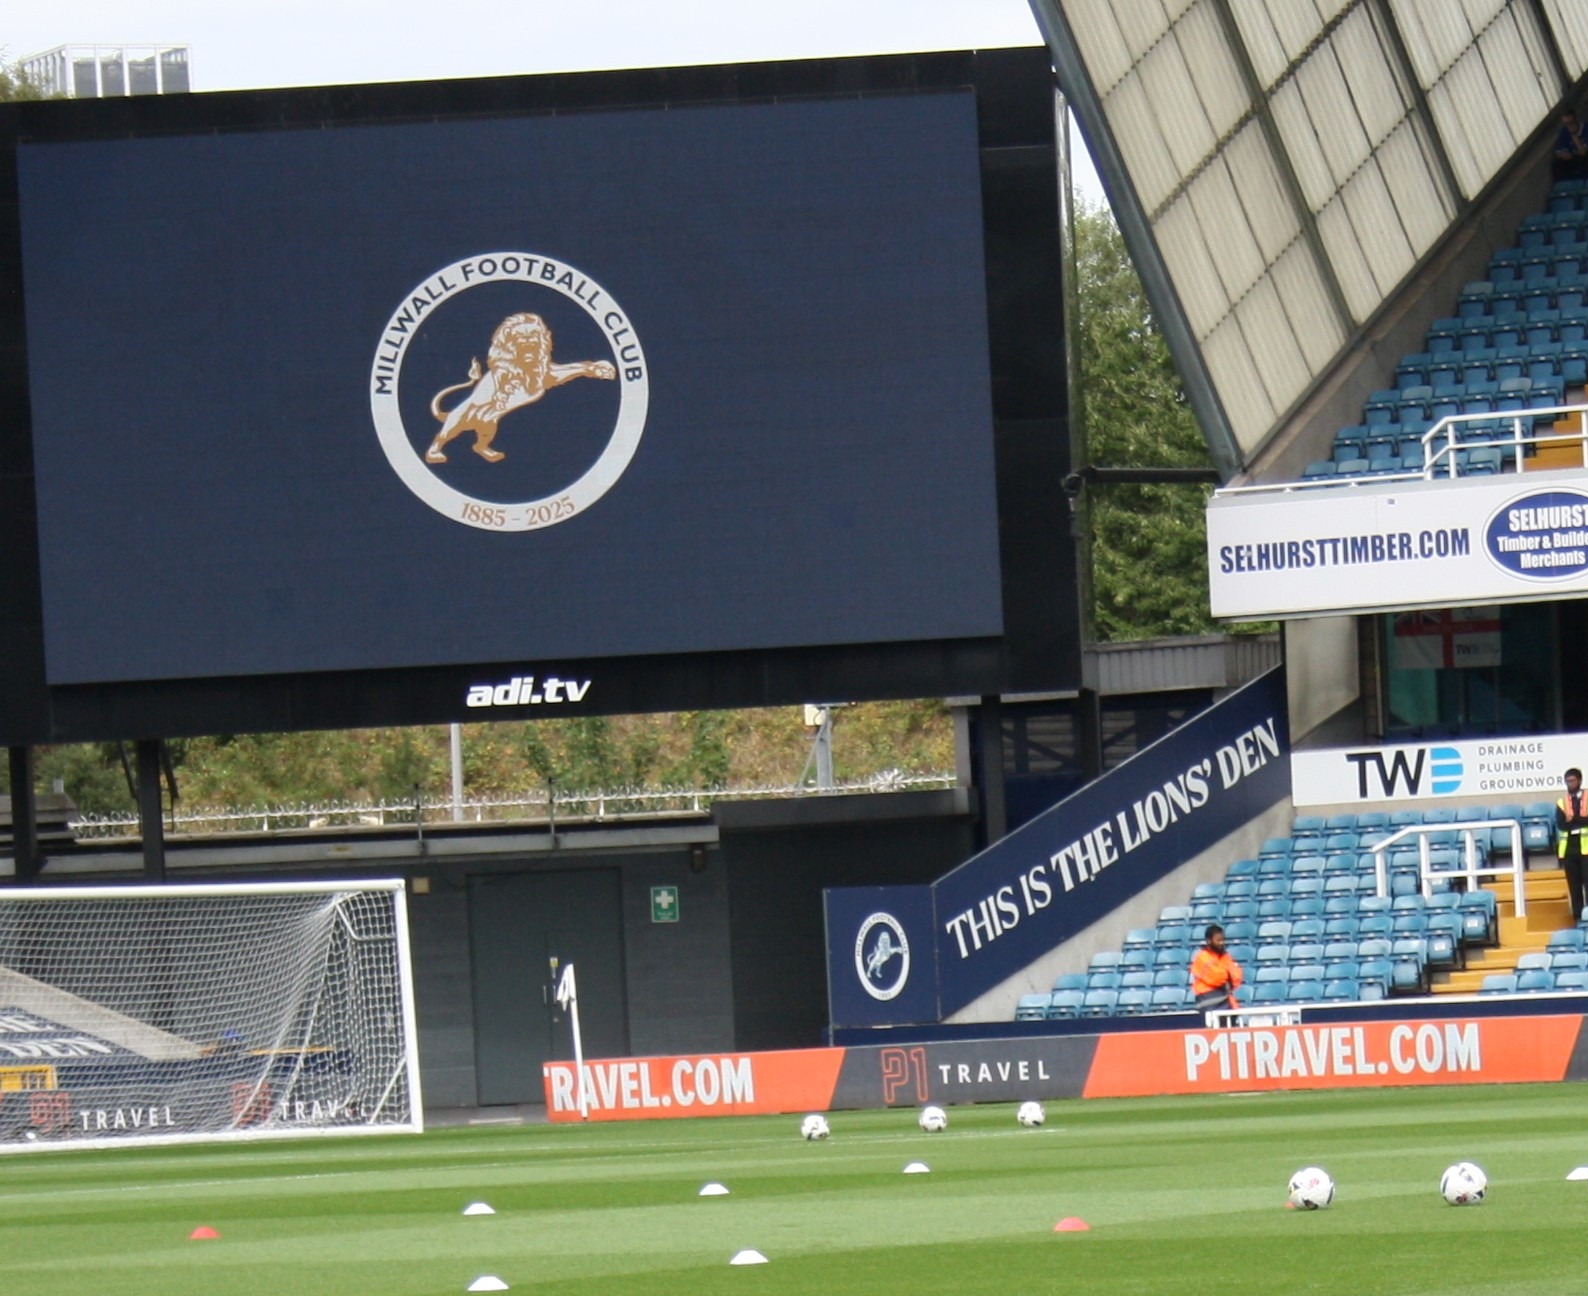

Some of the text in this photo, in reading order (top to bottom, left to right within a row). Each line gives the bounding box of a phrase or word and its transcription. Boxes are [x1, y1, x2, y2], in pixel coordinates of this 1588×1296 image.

[375, 256, 643, 395] MILLWALL FOOTBALL CLUB
[461, 502, 506, 528] 1885
[525, 495, 576, 526] 2025
[1219, 527, 1471, 574] SELHURSTTIMBER.COM
[1496, 535, 1541, 552] Timber
[1542, 535, 1552, 550] &
[1520, 550, 1586, 569] Merchants
[467, 676, 592, 708] adi.tv
[1478, 743, 1544, 756] DRAINAGE
[1479, 760, 1545, 773] PLUMBING
[1479, 776, 1565, 790] GROUNDWOR
[946, 886, 1019, 960] THIS
[1019, 866, 1052, 916] IS
[1050, 822, 1119, 893] THE
[1114, 758, 1212, 854] LIONS'
[1215, 717, 1280, 790] DEN
[1184, 1022, 1482, 1081] P1TRAVEL.COM
[880, 1046, 1050, 1103] P1 TRAVEL
[80, 1106, 176, 1131] TRAVEL
